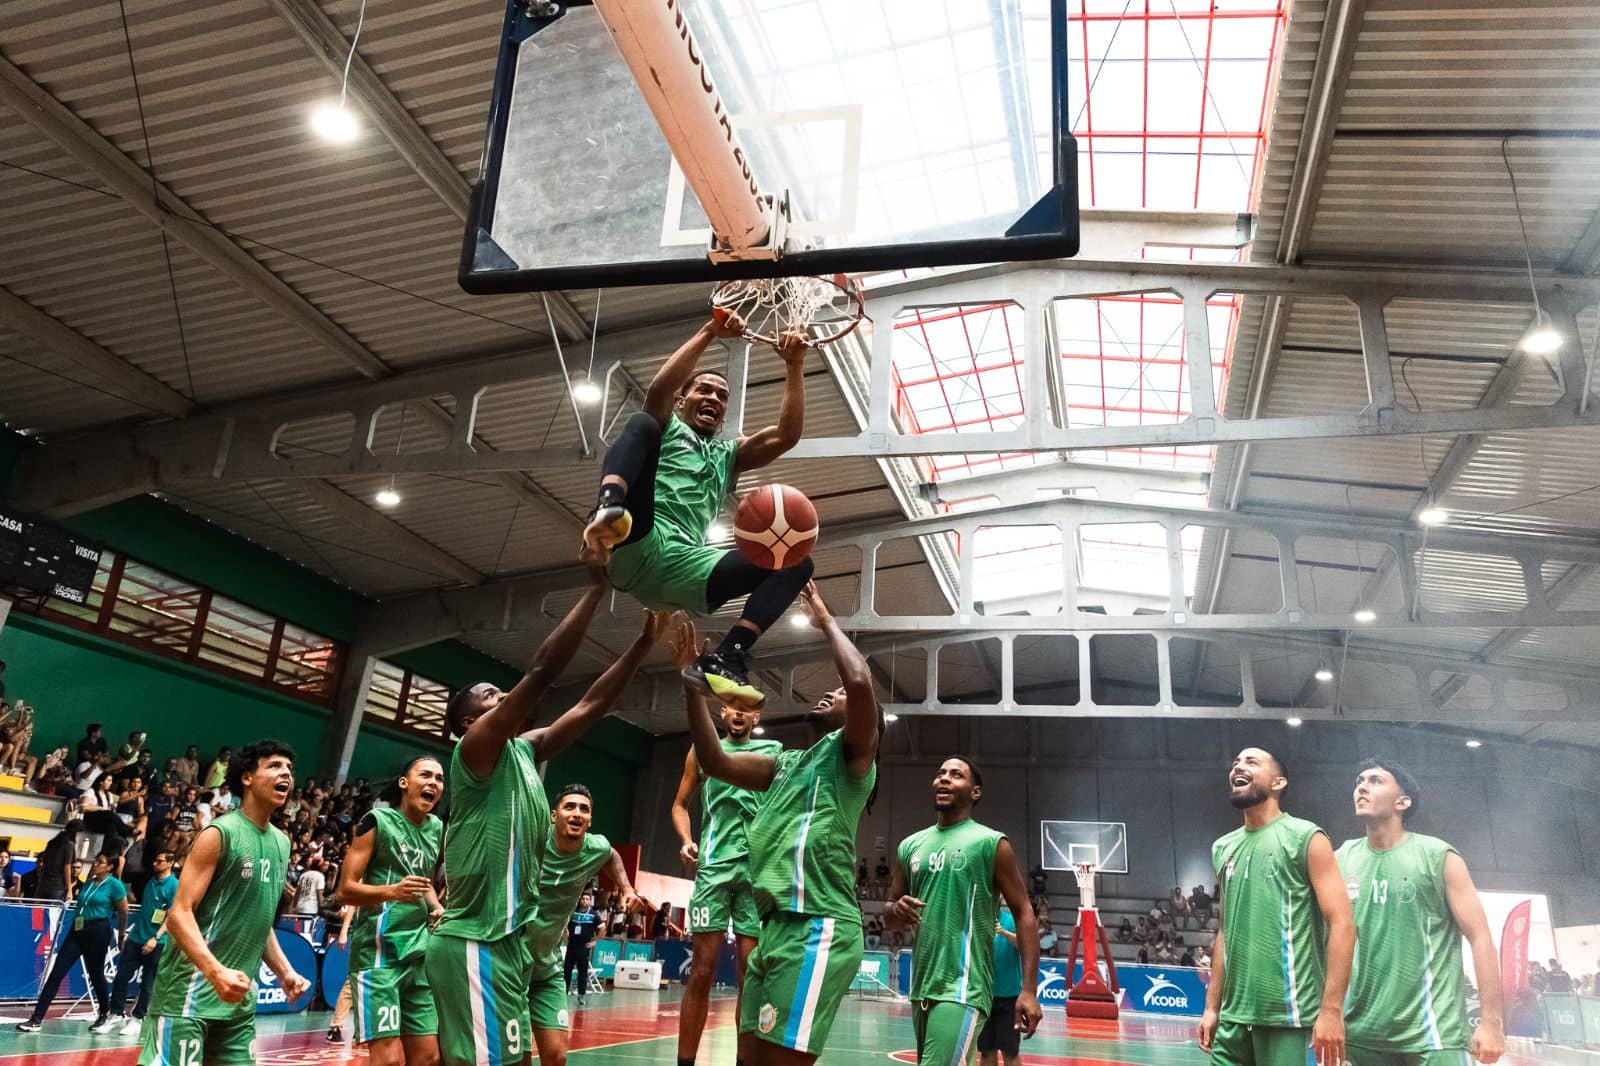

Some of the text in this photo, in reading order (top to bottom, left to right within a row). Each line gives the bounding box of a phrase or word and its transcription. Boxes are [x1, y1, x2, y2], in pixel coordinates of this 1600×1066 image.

[75, 545, 99, 562] VISITA
[412, 848, 424, 869] 21
[260, 858, 271, 882] 12
[554, 871, 564, 886] 7
[1372, 879, 1388, 904] 13
[692, 906, 710, 927] 98
[1042, 988, 1068, 1000] ICOD
[1151, 994, 1188, 1008] ICODER
[377, 1004, 400, 1033] 20
[506, 1018, 520, 1055] 9
[178, 1038, 202, 1066] 12
